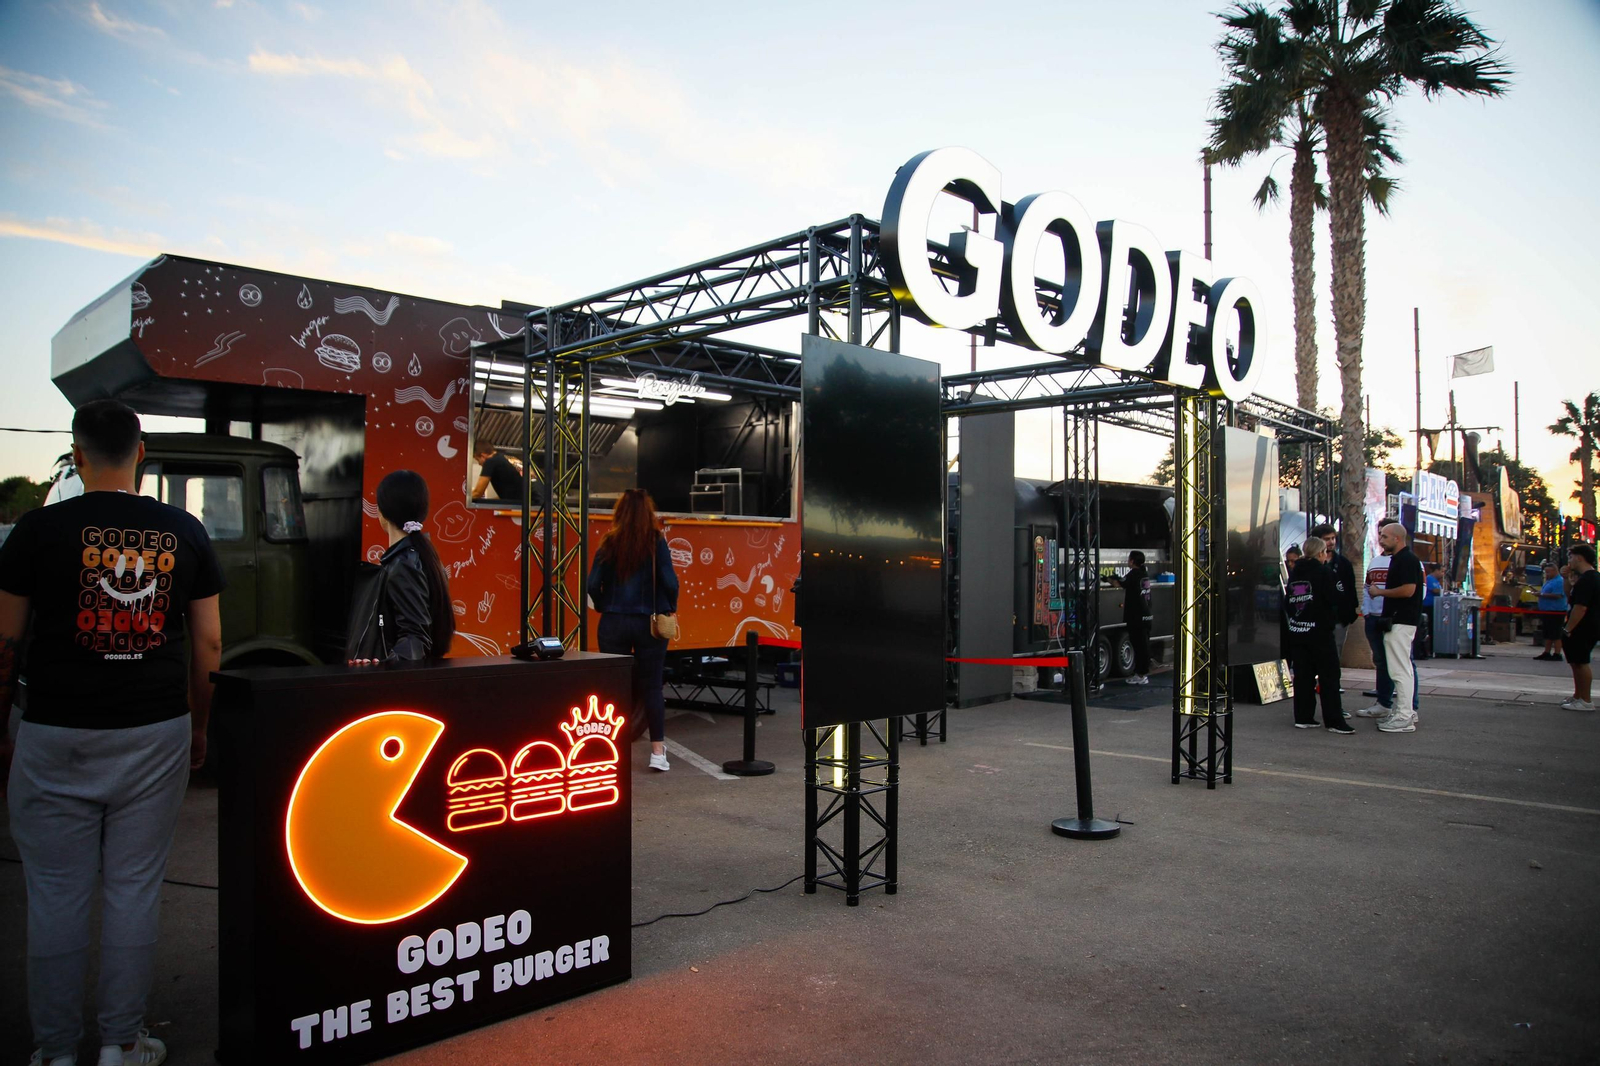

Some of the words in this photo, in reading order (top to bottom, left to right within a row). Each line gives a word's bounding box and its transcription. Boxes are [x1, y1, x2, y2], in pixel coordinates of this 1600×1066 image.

[884, 146, 1267, 402] GODEO
[290, 315, 330, 349] burger
[635, 370, 707, 406] Recogida
[81, 526, 178, 553] GODEO
[453, 549, 477, 579] good
[478, 525, 496, 556] vibes
[82, 546, 175, 573] GODEO
[80, 567, 173, 593] GODEO
[575, 722, 612, 737] GODEO
[397, 908, 533, 975] GODEO
[291, 998, 372, 1050] THE
[387, 969, 480, 1024] BEST
[492, 934, 610, 993] BURGER
